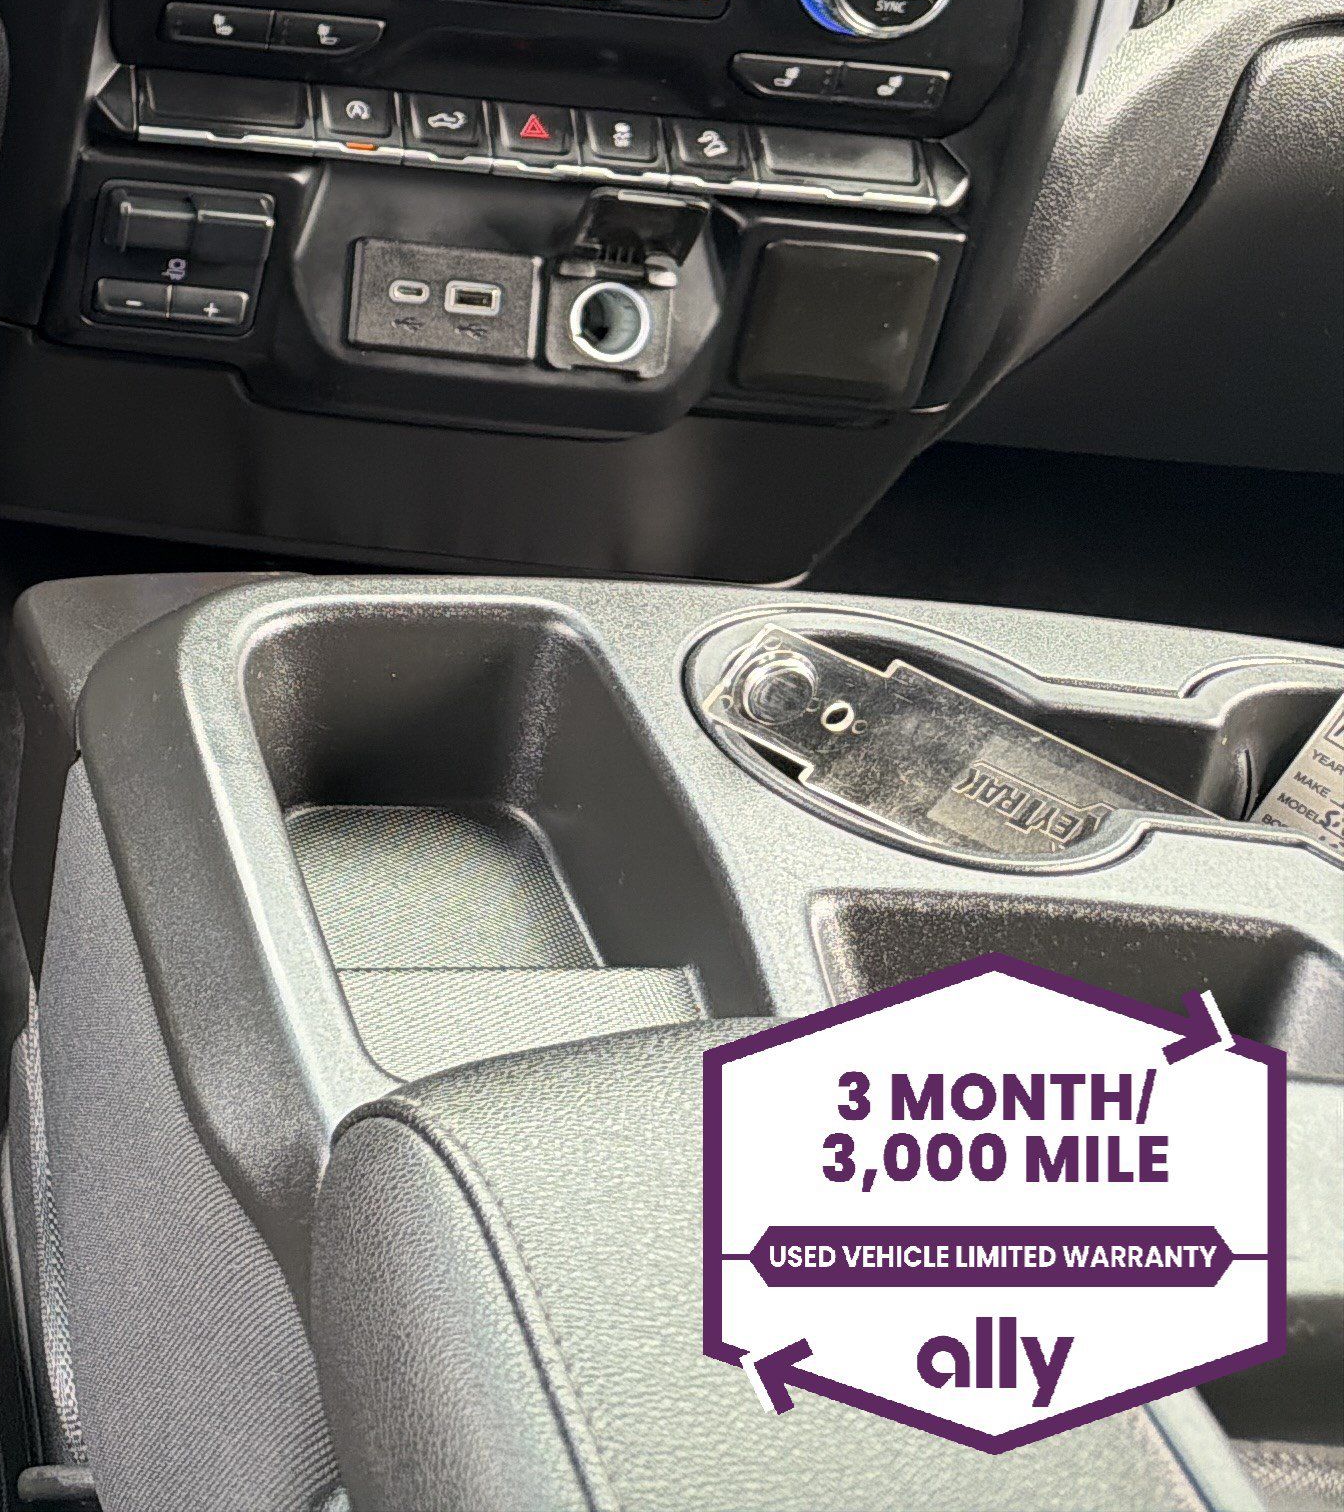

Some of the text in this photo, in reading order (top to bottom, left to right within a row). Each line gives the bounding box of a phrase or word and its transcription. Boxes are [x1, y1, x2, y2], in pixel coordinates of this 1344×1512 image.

[874, 0, 908, 14] SYNC
[1294, 771, 1332, 798] MAKE
[1277, 792, 1322, 825] MODEL
